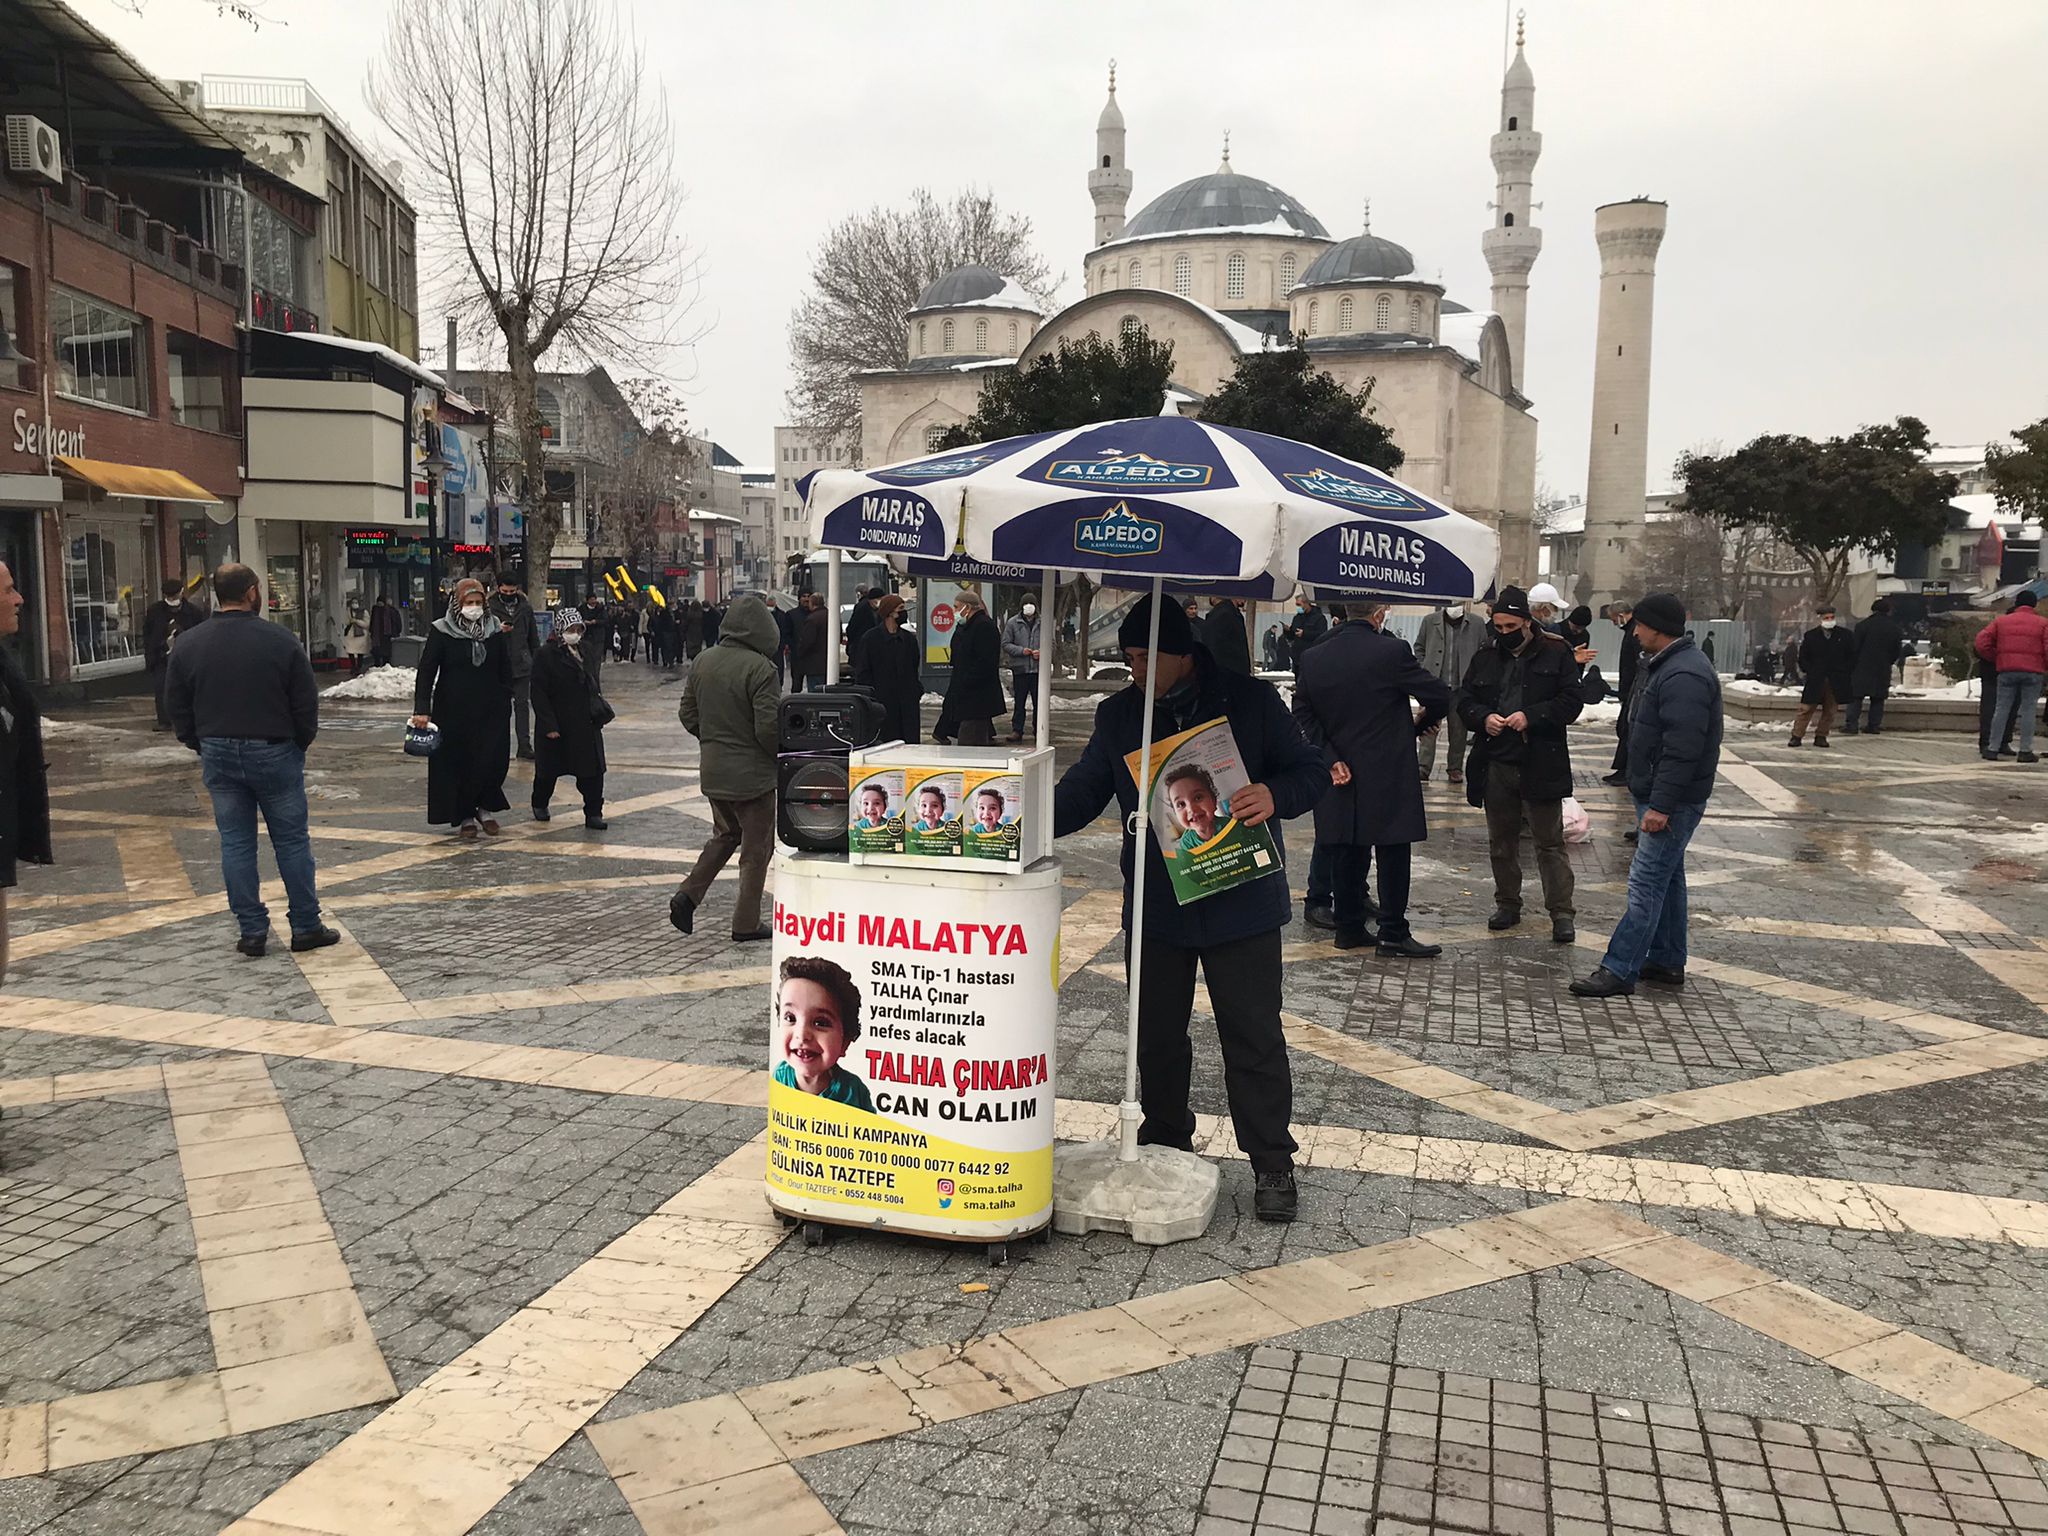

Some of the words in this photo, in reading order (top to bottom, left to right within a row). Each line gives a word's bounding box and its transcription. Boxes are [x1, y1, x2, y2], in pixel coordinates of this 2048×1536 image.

[1059, 464, 1200, 478] ALPEDO
[1300, 478, 1406, 502] ALPEDO
[862, 496, 926, 531] MARAŞ
[860, 527, 921, 548] DONDURMASI
[1080, 525, 1157, 543] ALPEDO
[1340, 527, 1426, 569] MARAŞ
[1339, 561, 1425, 586] DONDURMASI
[774, 900, 845, 947] Haydi
[858, 914, 1028, 956] MALATYA
[871, 961, 907, 979] SMA
[911, 965, 951, 984] Tip-1
[957, 968, 1015, 985] hastası
[871, 981, 923, 1001] TALHA
[927, 987, 969, 1006] Çınar
[870, 1004, 986, 1027] yardımlarınızla
[869, 1024, 911, 1041] nefes
[916, 1028, 967, 1047] alacak
[865, 1049, 947, 1088] TALHA
[876, 1093, 929, 1118] CAN
[938, 1098, 1037, 1123] OLALIM
[772, 1108, 808, 1133] VALİLİK
[811, 1117, 849, 1139] İZİNLİ
[853, 1126, 928, 1149] KAMPANYA
[772, 1149, 825, 1179] GÜLNİSA
[829, 1165, 896, 1189] TAZTEPE
[795, 1139, 822, 1156] TR56
[826, 1145, 855, 1160] 0006
[859, 1149, 888, 1165] 7010
[891, 1154, 921, 1169] 0000
[925, 1158, 955, 1173] 0077
[959, 1162, 990, 1175] 6442
[994, 1162, 1010, 1175] 92
[805, 1182, 837, 1195] TAZTEPE
[845, 1189, 865, 1199] 0552
[867, 1191, 882, 1201] 448
[884, 1194, 904, 1205] 5004
[959, 1183, 1023, 1194] @sma.talha
[963, 1199, 1016, 1210] sma.talha
